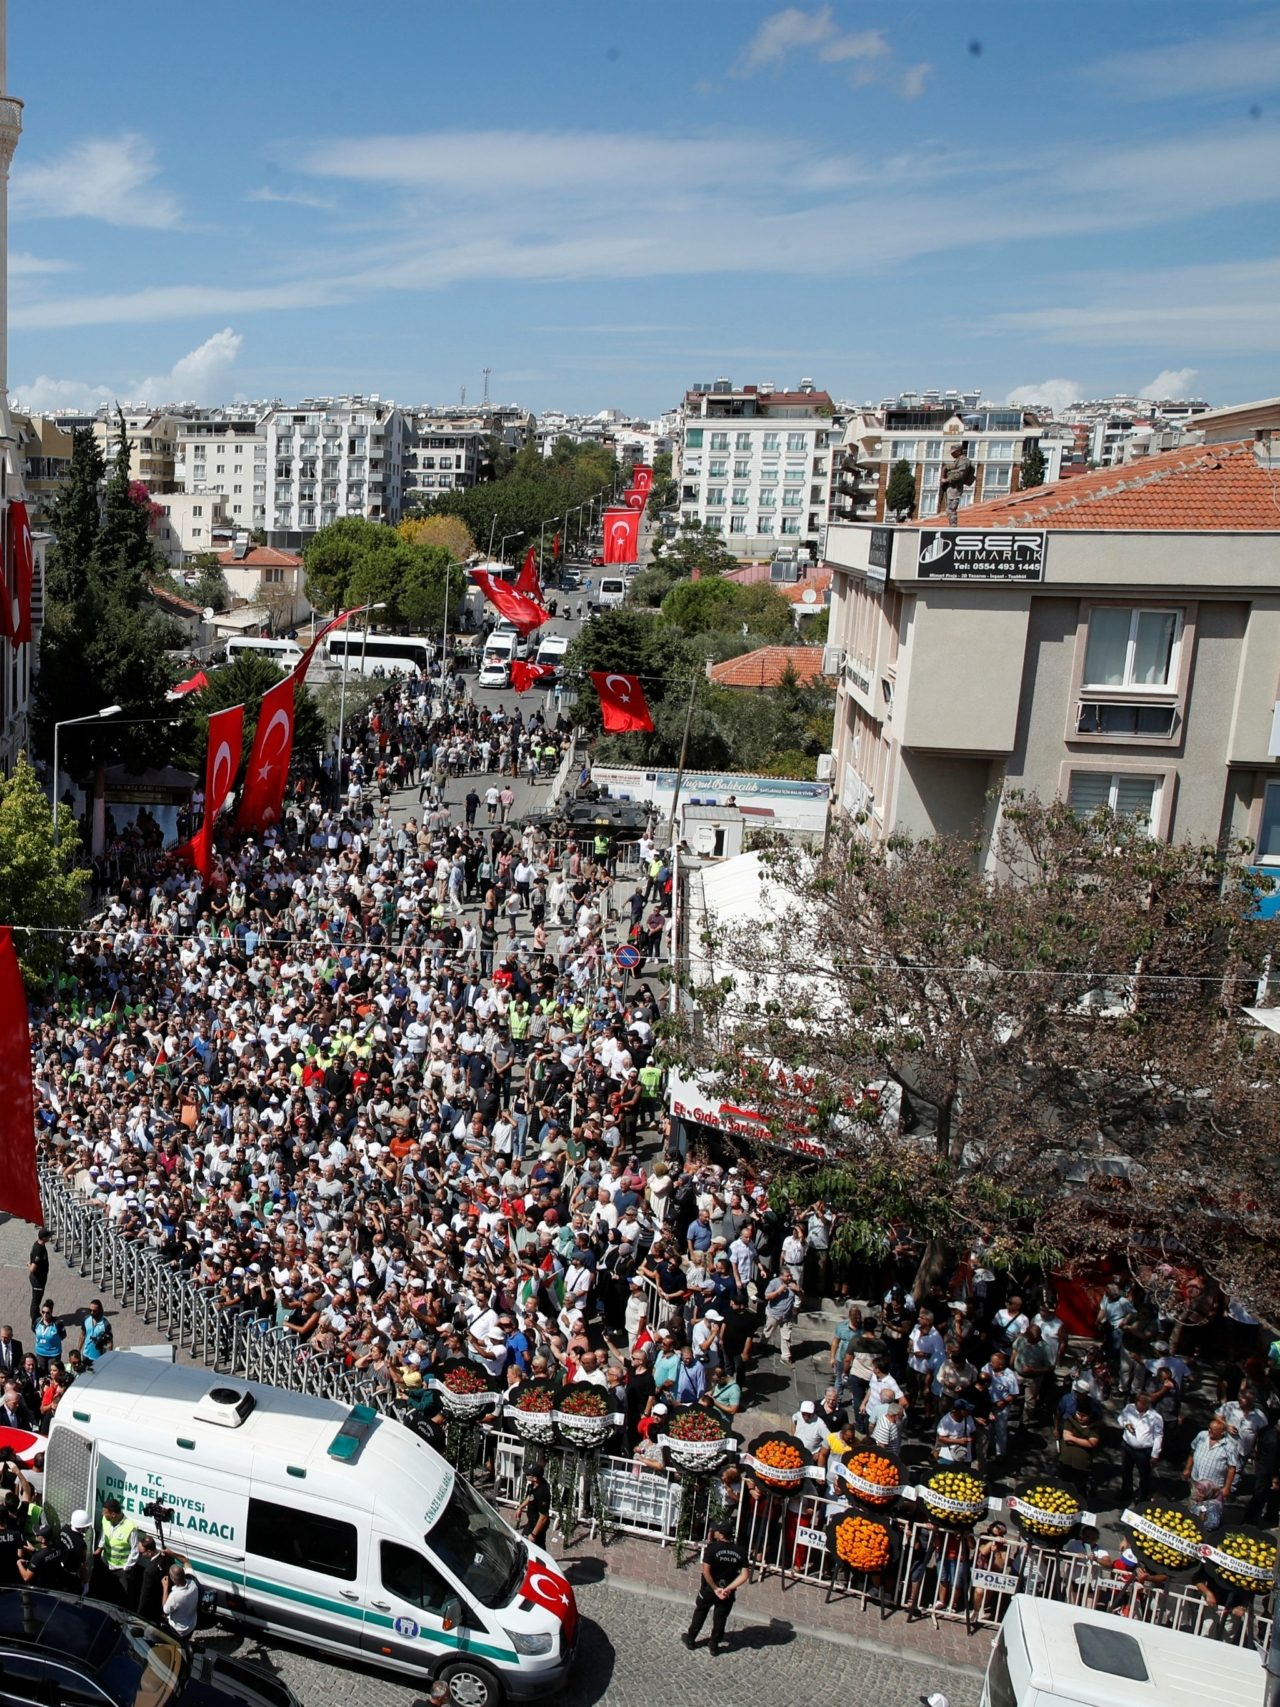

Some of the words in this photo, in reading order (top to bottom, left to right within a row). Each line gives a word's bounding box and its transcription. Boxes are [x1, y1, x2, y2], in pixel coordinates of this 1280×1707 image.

[954, 535, 1042, 551] SER
[953, 562, 971, 570] Tel:
[973, 562, 996, 570] 0554
[998, 562, 1015, 570] 493
[1017, 563, 1041, 571] 1445
[693, 1107, 718, 1125] Gıda
[146, 1473, 166, 1488] T.C.
[849, 1473, 875, 1489] HATİCE
[106, 1475, 139, 1495] DİDİM
[141, 1485, 206, 1514] BELEDİYESİ
[926, 1490, 964, 1508] GÖKHAN
[95, 1487, 135, 1513] NAZE
[186, 1515, 236, 1541] ARACI
[423, 1498, 441, 1525] CENAZE
[1023, 1510, 1054, 1525] HALUK
[1033, 1509, 1056, 1520] AYDIN
[799, 1529, 825, 1544] POL
[1139, 1518, 1185, 1546] SEBAHATTİN
[1156, 1535, 1175, 1547] DİDİM
[1213, 1550, 1229, 1561] MHP
[1229, 1558, 1253, 1571] DİDİM
[1219, 1560, 1260, 1578] MUSTAFA
[974, 1572, 1016, 1587] POLİS
[984, 1582, 1006, 1590] AYDIN
